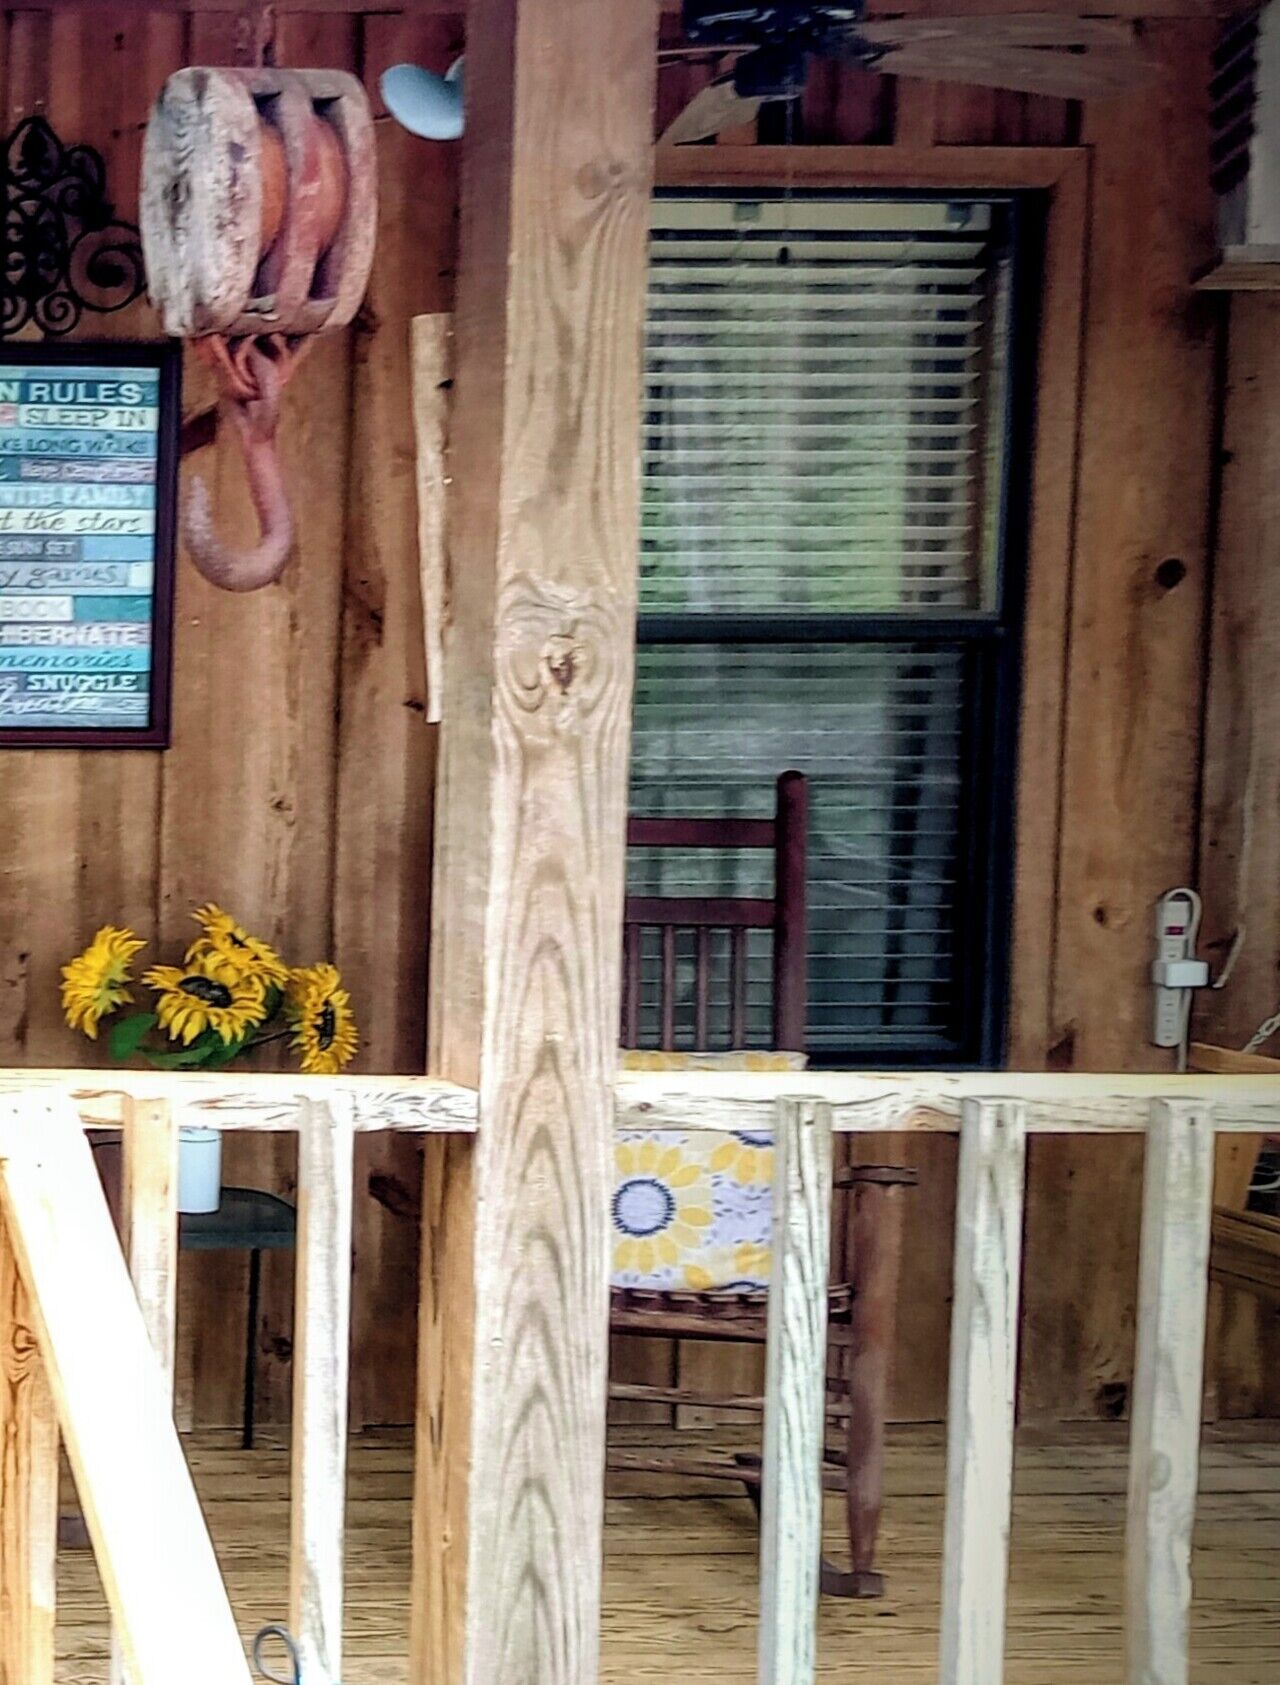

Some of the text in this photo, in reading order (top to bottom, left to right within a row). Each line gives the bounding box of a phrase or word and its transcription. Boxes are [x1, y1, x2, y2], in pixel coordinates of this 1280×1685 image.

[29, 382, 142, 404] RULES
[25, 408, 146, 427] SLEEP IN
[26, 439, 82, 453] LONG
[0, 486, 59, 504] WITH
[63, 486, 144, 505] FAMILY
[23, 502, 66, 531] the
[75, 512, 143, 532] stars
[25, 565, 118, 588] games
[26, 674, 138, 692] SNUGGLE
